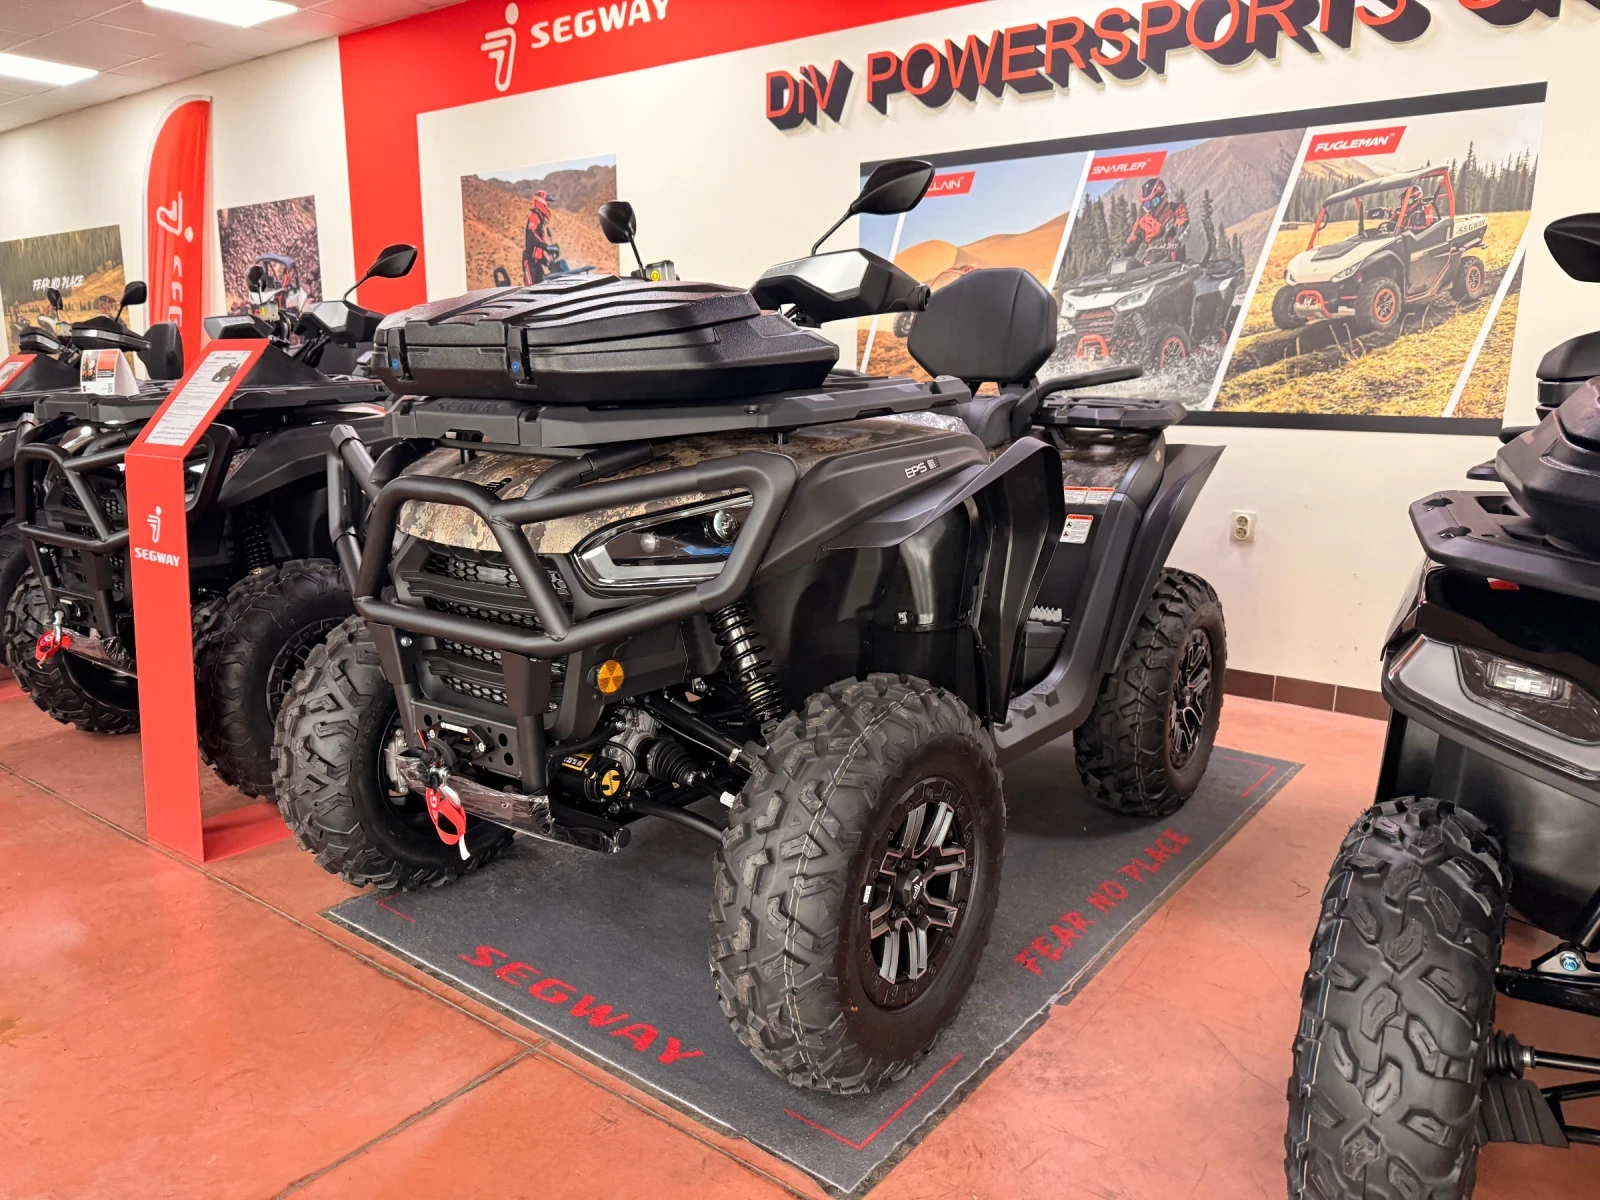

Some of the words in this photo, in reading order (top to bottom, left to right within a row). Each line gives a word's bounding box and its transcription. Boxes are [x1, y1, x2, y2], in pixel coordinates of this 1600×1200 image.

[530, 0, 669, 49] SEGWAY
[32, 277, 50, 292] FEAR
[50, 275, 61, 290] NO
[61, 274, 85, 290] PLACE
[435, 400, 503, 416] SEGWAY
[904, 461, 928, 479] EPS
[134, 547, 180, 567] SEGWAY
[1013, 910, 1096, 977] FEAR
[1085, 879, 1129, 915] NO
[1117, 826, 1192, 883] PLACE
[459, 944, 705, 1066] SEGWAY
